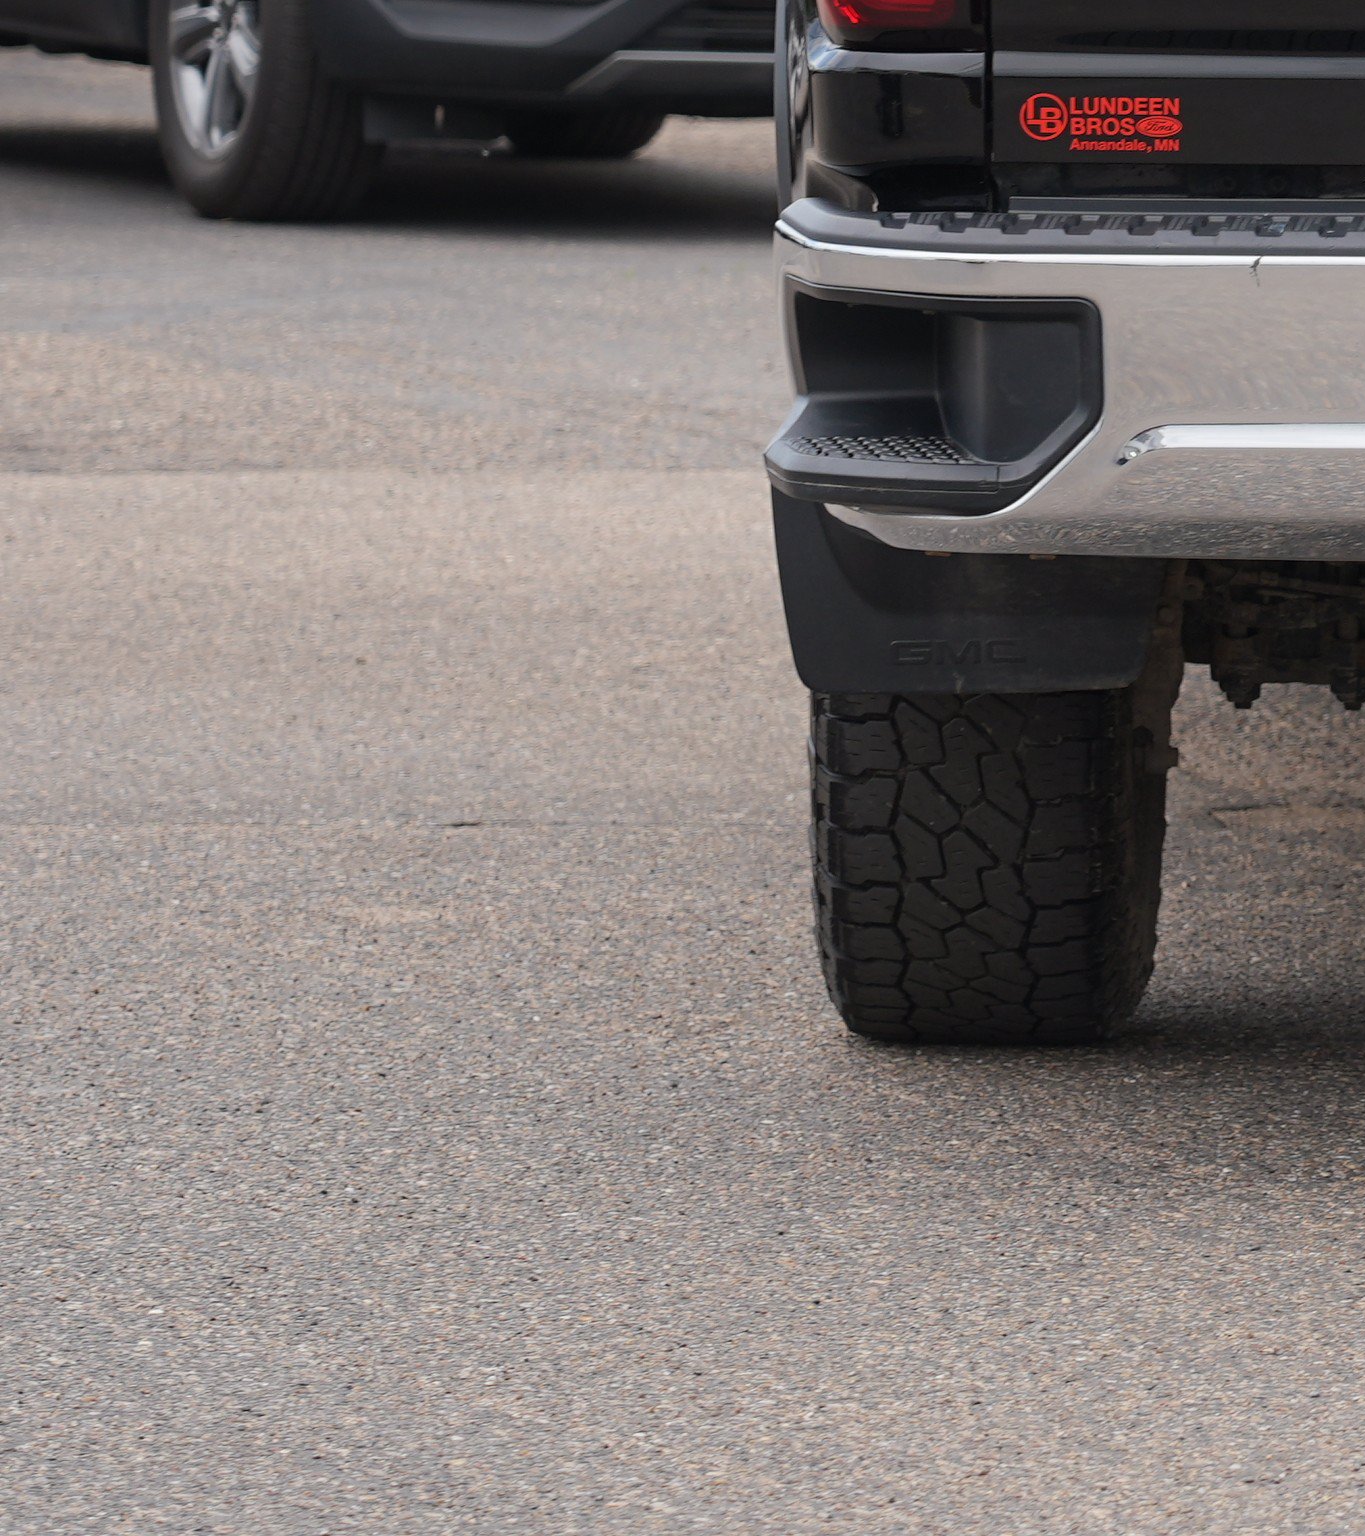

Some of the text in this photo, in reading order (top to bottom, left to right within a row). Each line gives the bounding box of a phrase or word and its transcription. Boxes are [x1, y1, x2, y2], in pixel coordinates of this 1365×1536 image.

[1069, 96, 1181, 116] LUNDEEN
[1069, 117, 1136, 136] BROS
[1069, 137, 1180, 154] Annandale, MN
